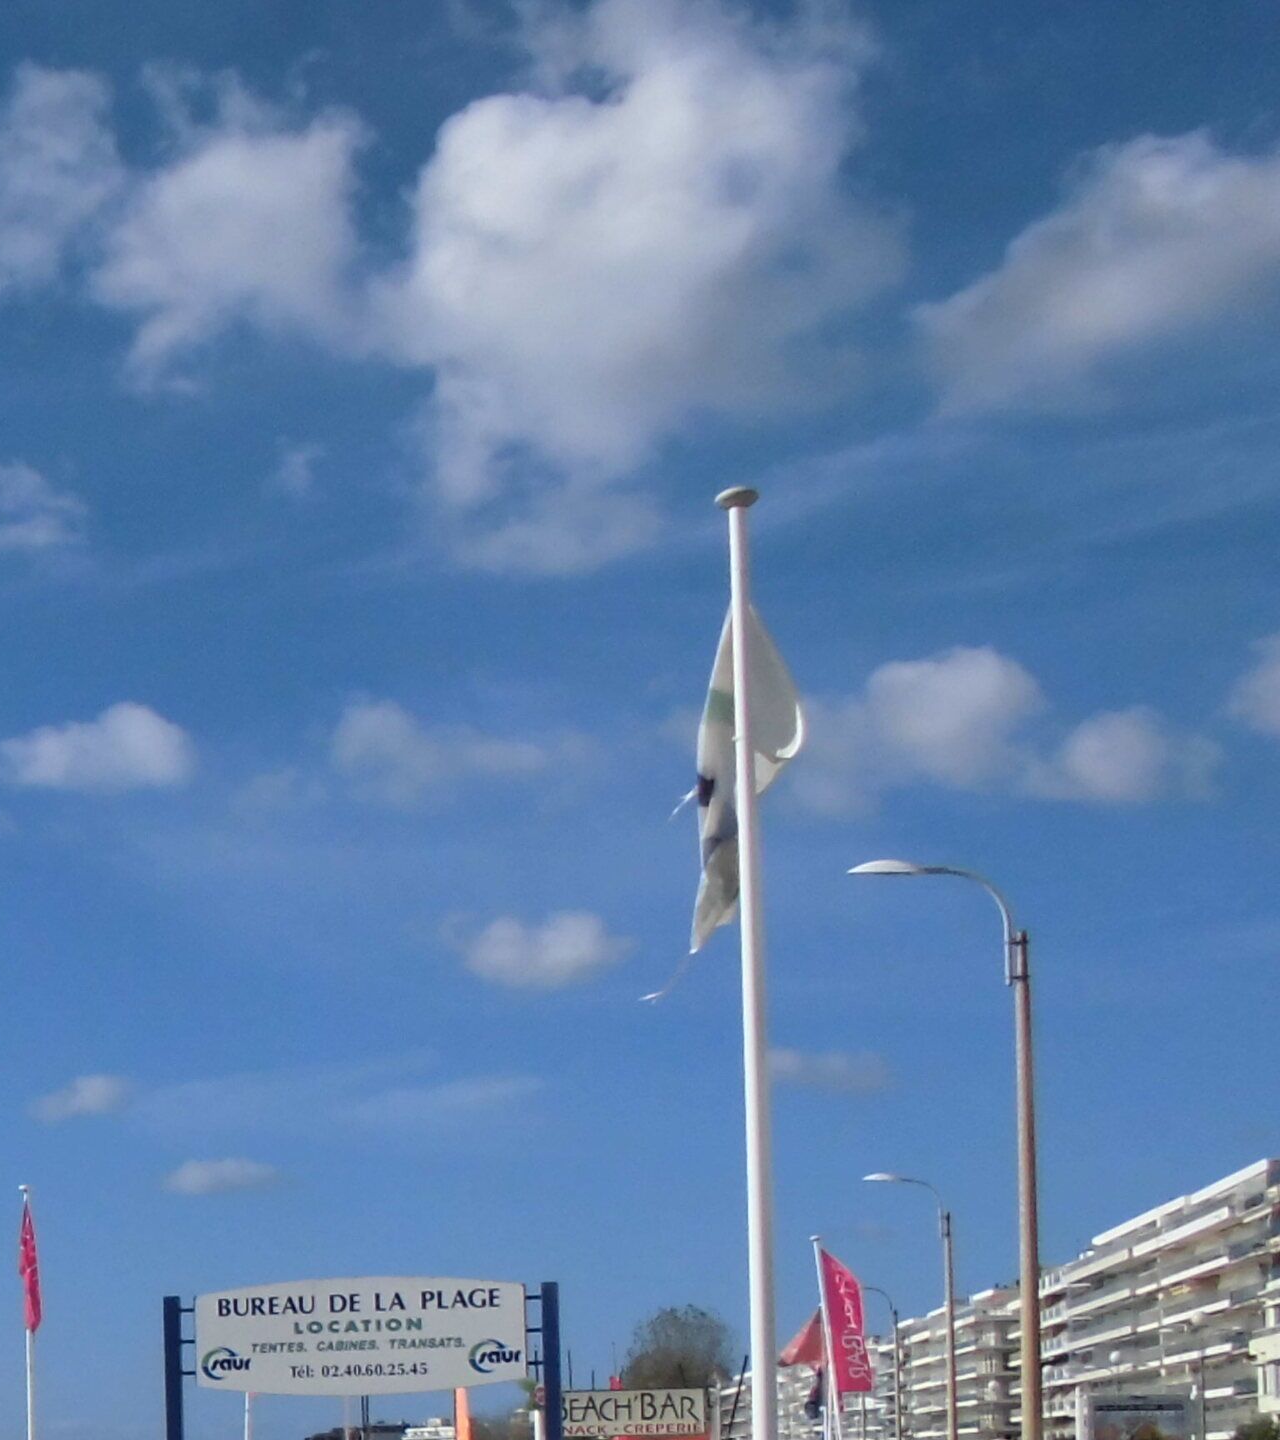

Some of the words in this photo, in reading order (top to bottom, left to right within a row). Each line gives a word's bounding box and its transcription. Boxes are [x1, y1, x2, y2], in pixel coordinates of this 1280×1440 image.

[218, 1294, 315, 1317] BUREAU
[330, 1293, 361, 1313] DE
[375, 1291, 406, 1311] LA
[420, 1288, 502, 1310] PLAGE
[294, 1317, 424, 1335] LOCATION
[290, 1364, 315, 1379] Tél:
[321, 1362, 428, 1378] 02.40.60.25.45
[561, 1425, 607, 1435] NACK
